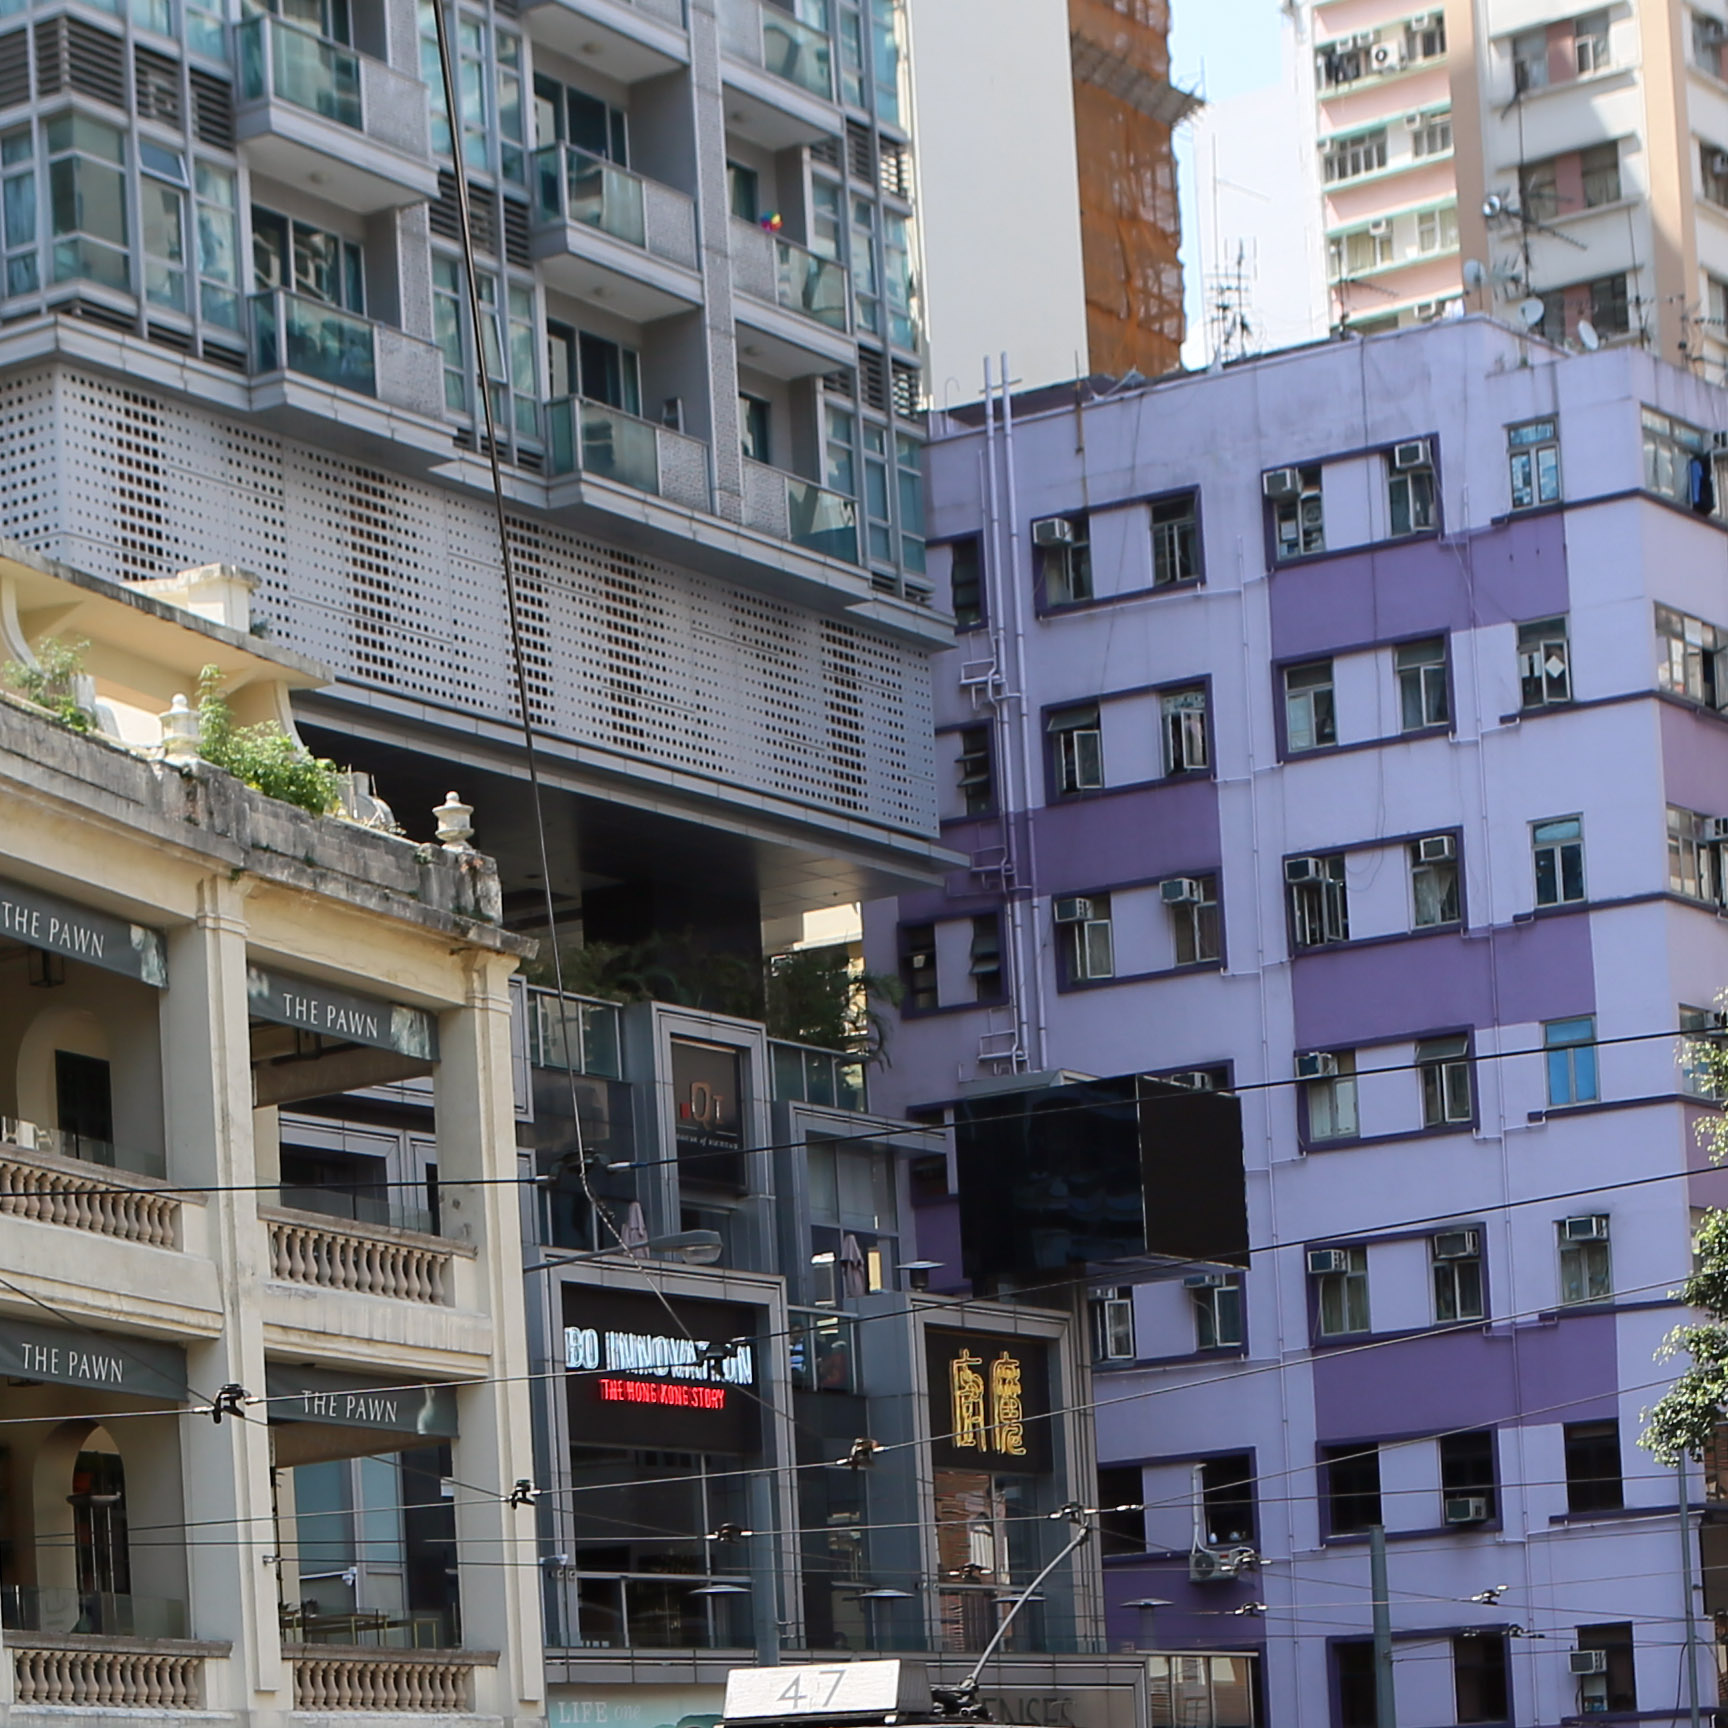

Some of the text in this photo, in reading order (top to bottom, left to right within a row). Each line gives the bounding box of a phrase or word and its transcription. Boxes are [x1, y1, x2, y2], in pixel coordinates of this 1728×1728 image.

[2, 898, 105, 959] THE PAWN
[283, 991, 378, 1039] THE PAWN
[22, 1344, 124, 1384] THE PAWN
[301, 1390, 397, 1424] THE PAWN
[600, 1379, 725, 1409] THE HONG KONG STORY
[776, 1669, 847, 1709] 47
[558, 1702, 642, 1724] LIFE one
